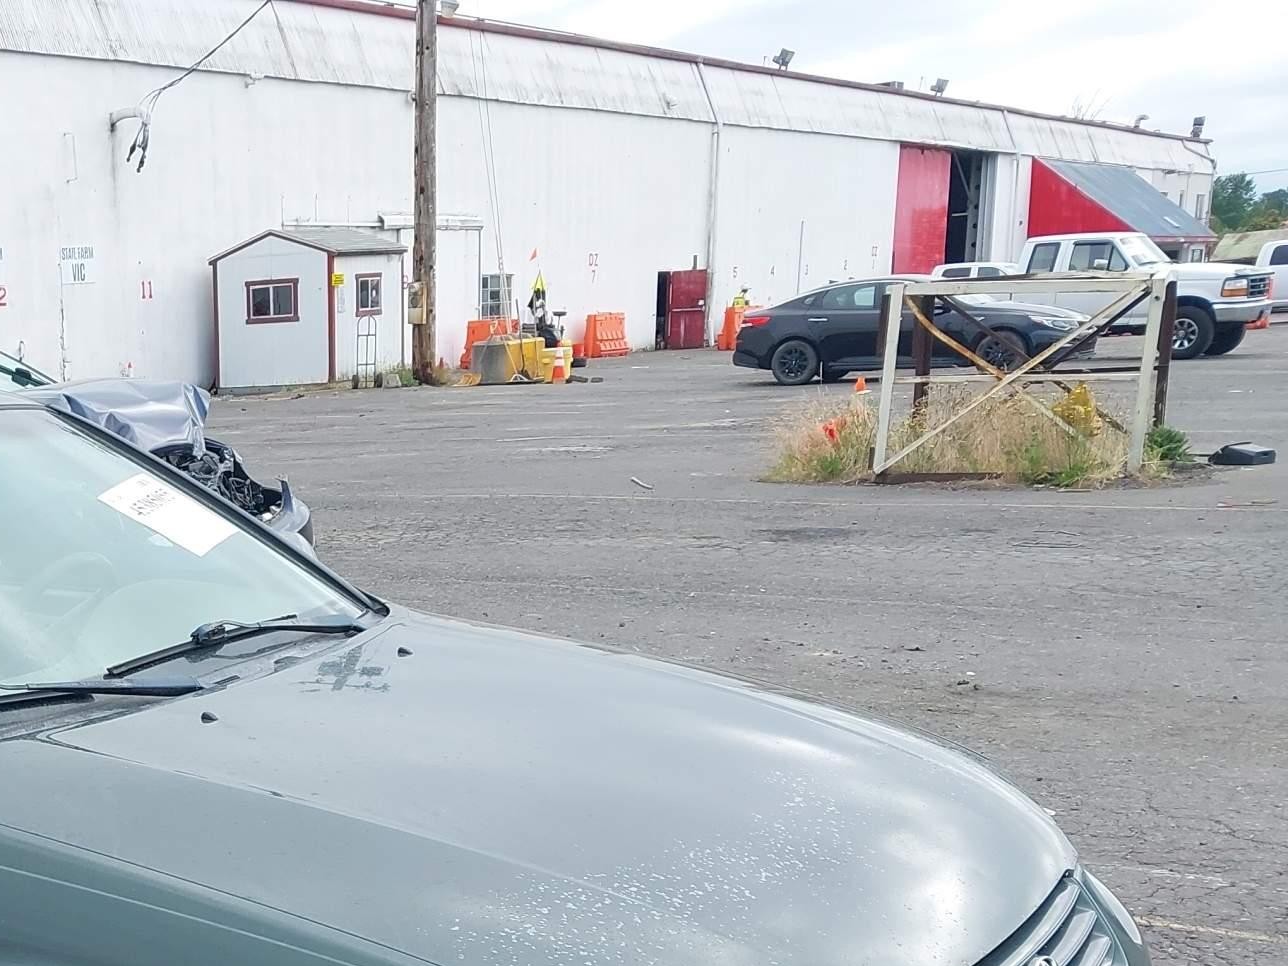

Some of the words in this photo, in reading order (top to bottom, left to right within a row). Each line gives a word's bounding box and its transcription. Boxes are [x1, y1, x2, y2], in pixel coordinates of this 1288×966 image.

[62, 247, 78, 261] STATE
[78, 246, 94, 260] FARM
[72, 263, 86, 282] VIC
[141, 281, 153, 299] 11
